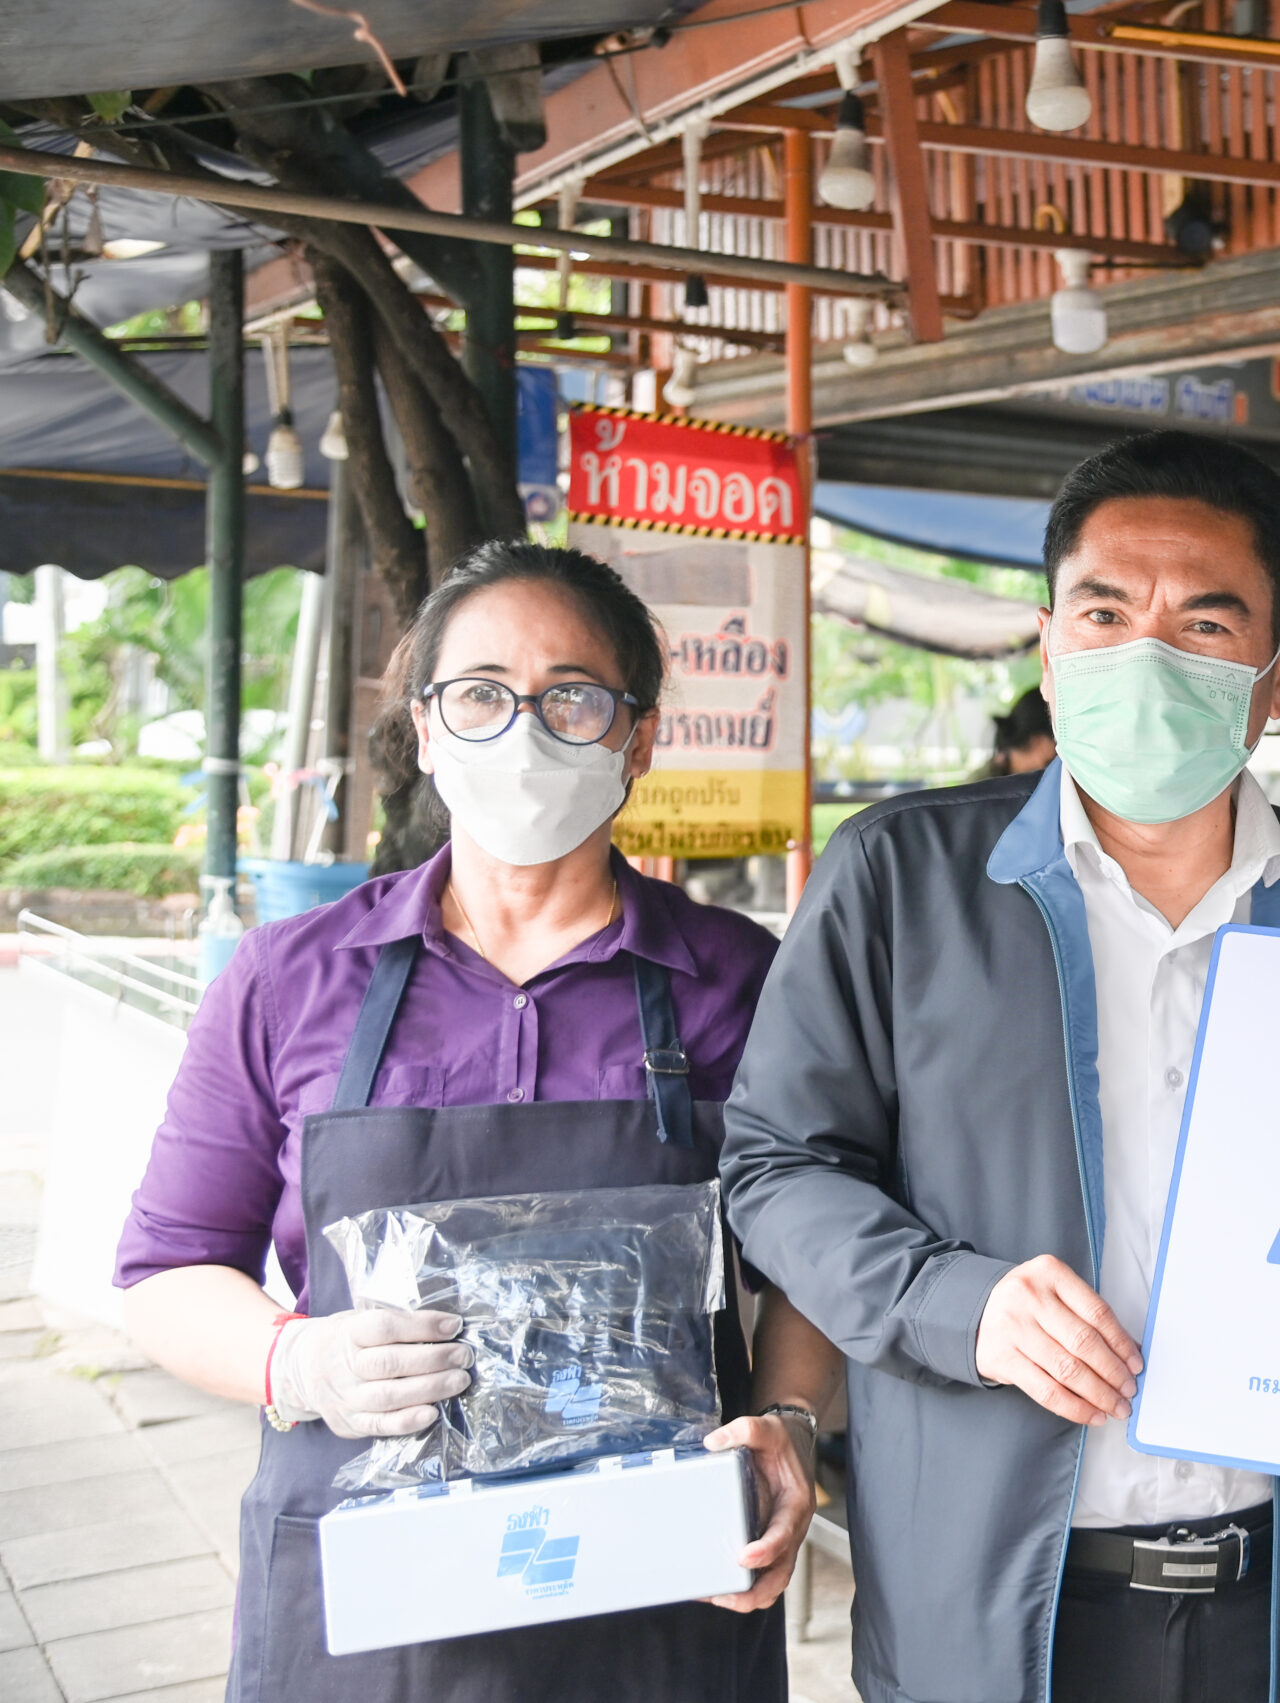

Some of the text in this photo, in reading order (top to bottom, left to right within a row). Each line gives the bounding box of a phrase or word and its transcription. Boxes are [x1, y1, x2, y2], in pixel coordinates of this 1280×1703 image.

[580, 419, 793, 527] ห้ามจอด
[507, 1504, 550, 1531] ธงฟ้า
